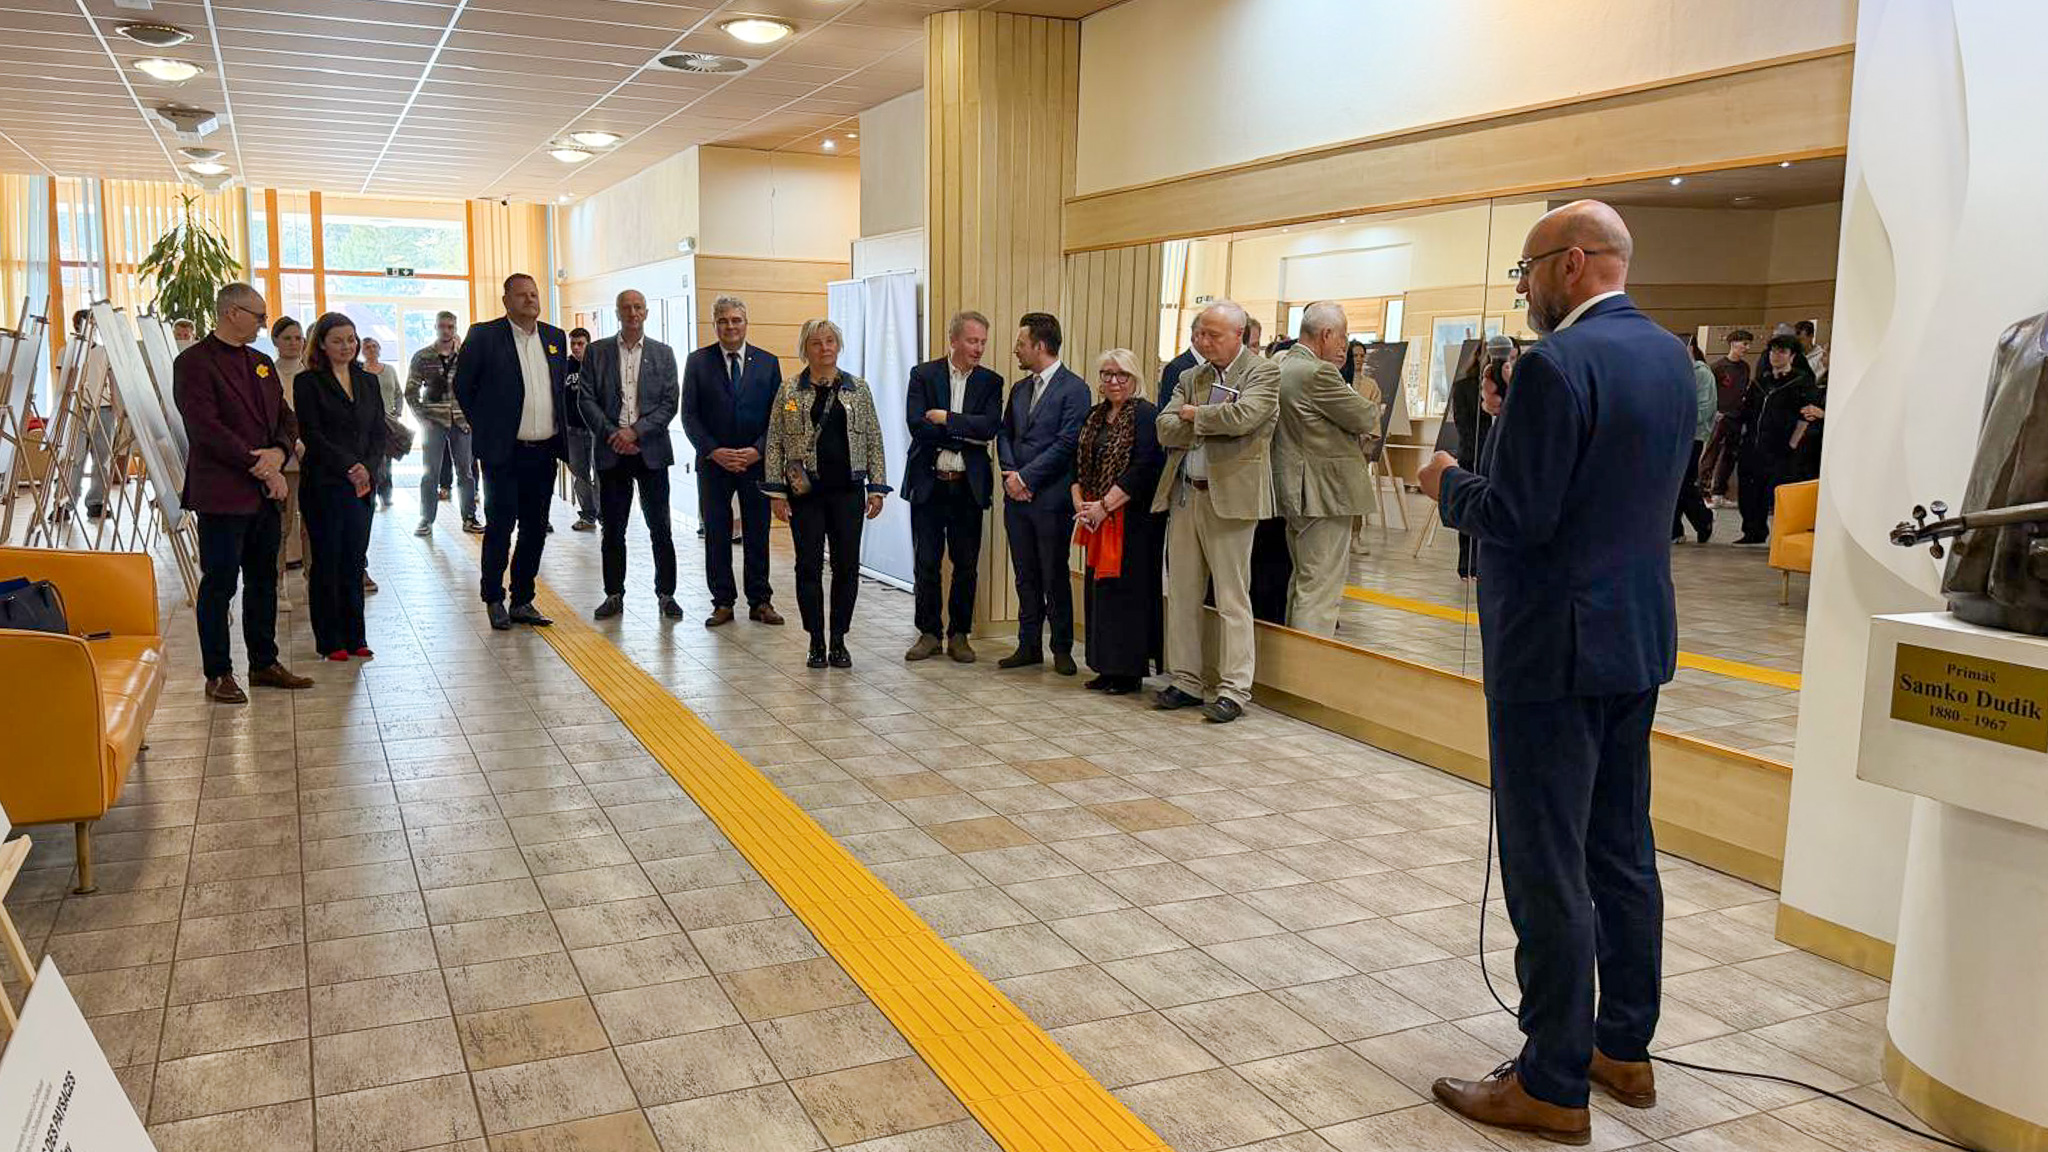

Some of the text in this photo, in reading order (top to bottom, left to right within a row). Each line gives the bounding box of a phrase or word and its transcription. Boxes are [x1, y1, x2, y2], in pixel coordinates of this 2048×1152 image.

[1900, 673, 1969, 704] Samko
[1929, 704, 1960, 722] 1880
[1975, 714, 2008, 732] 1967
